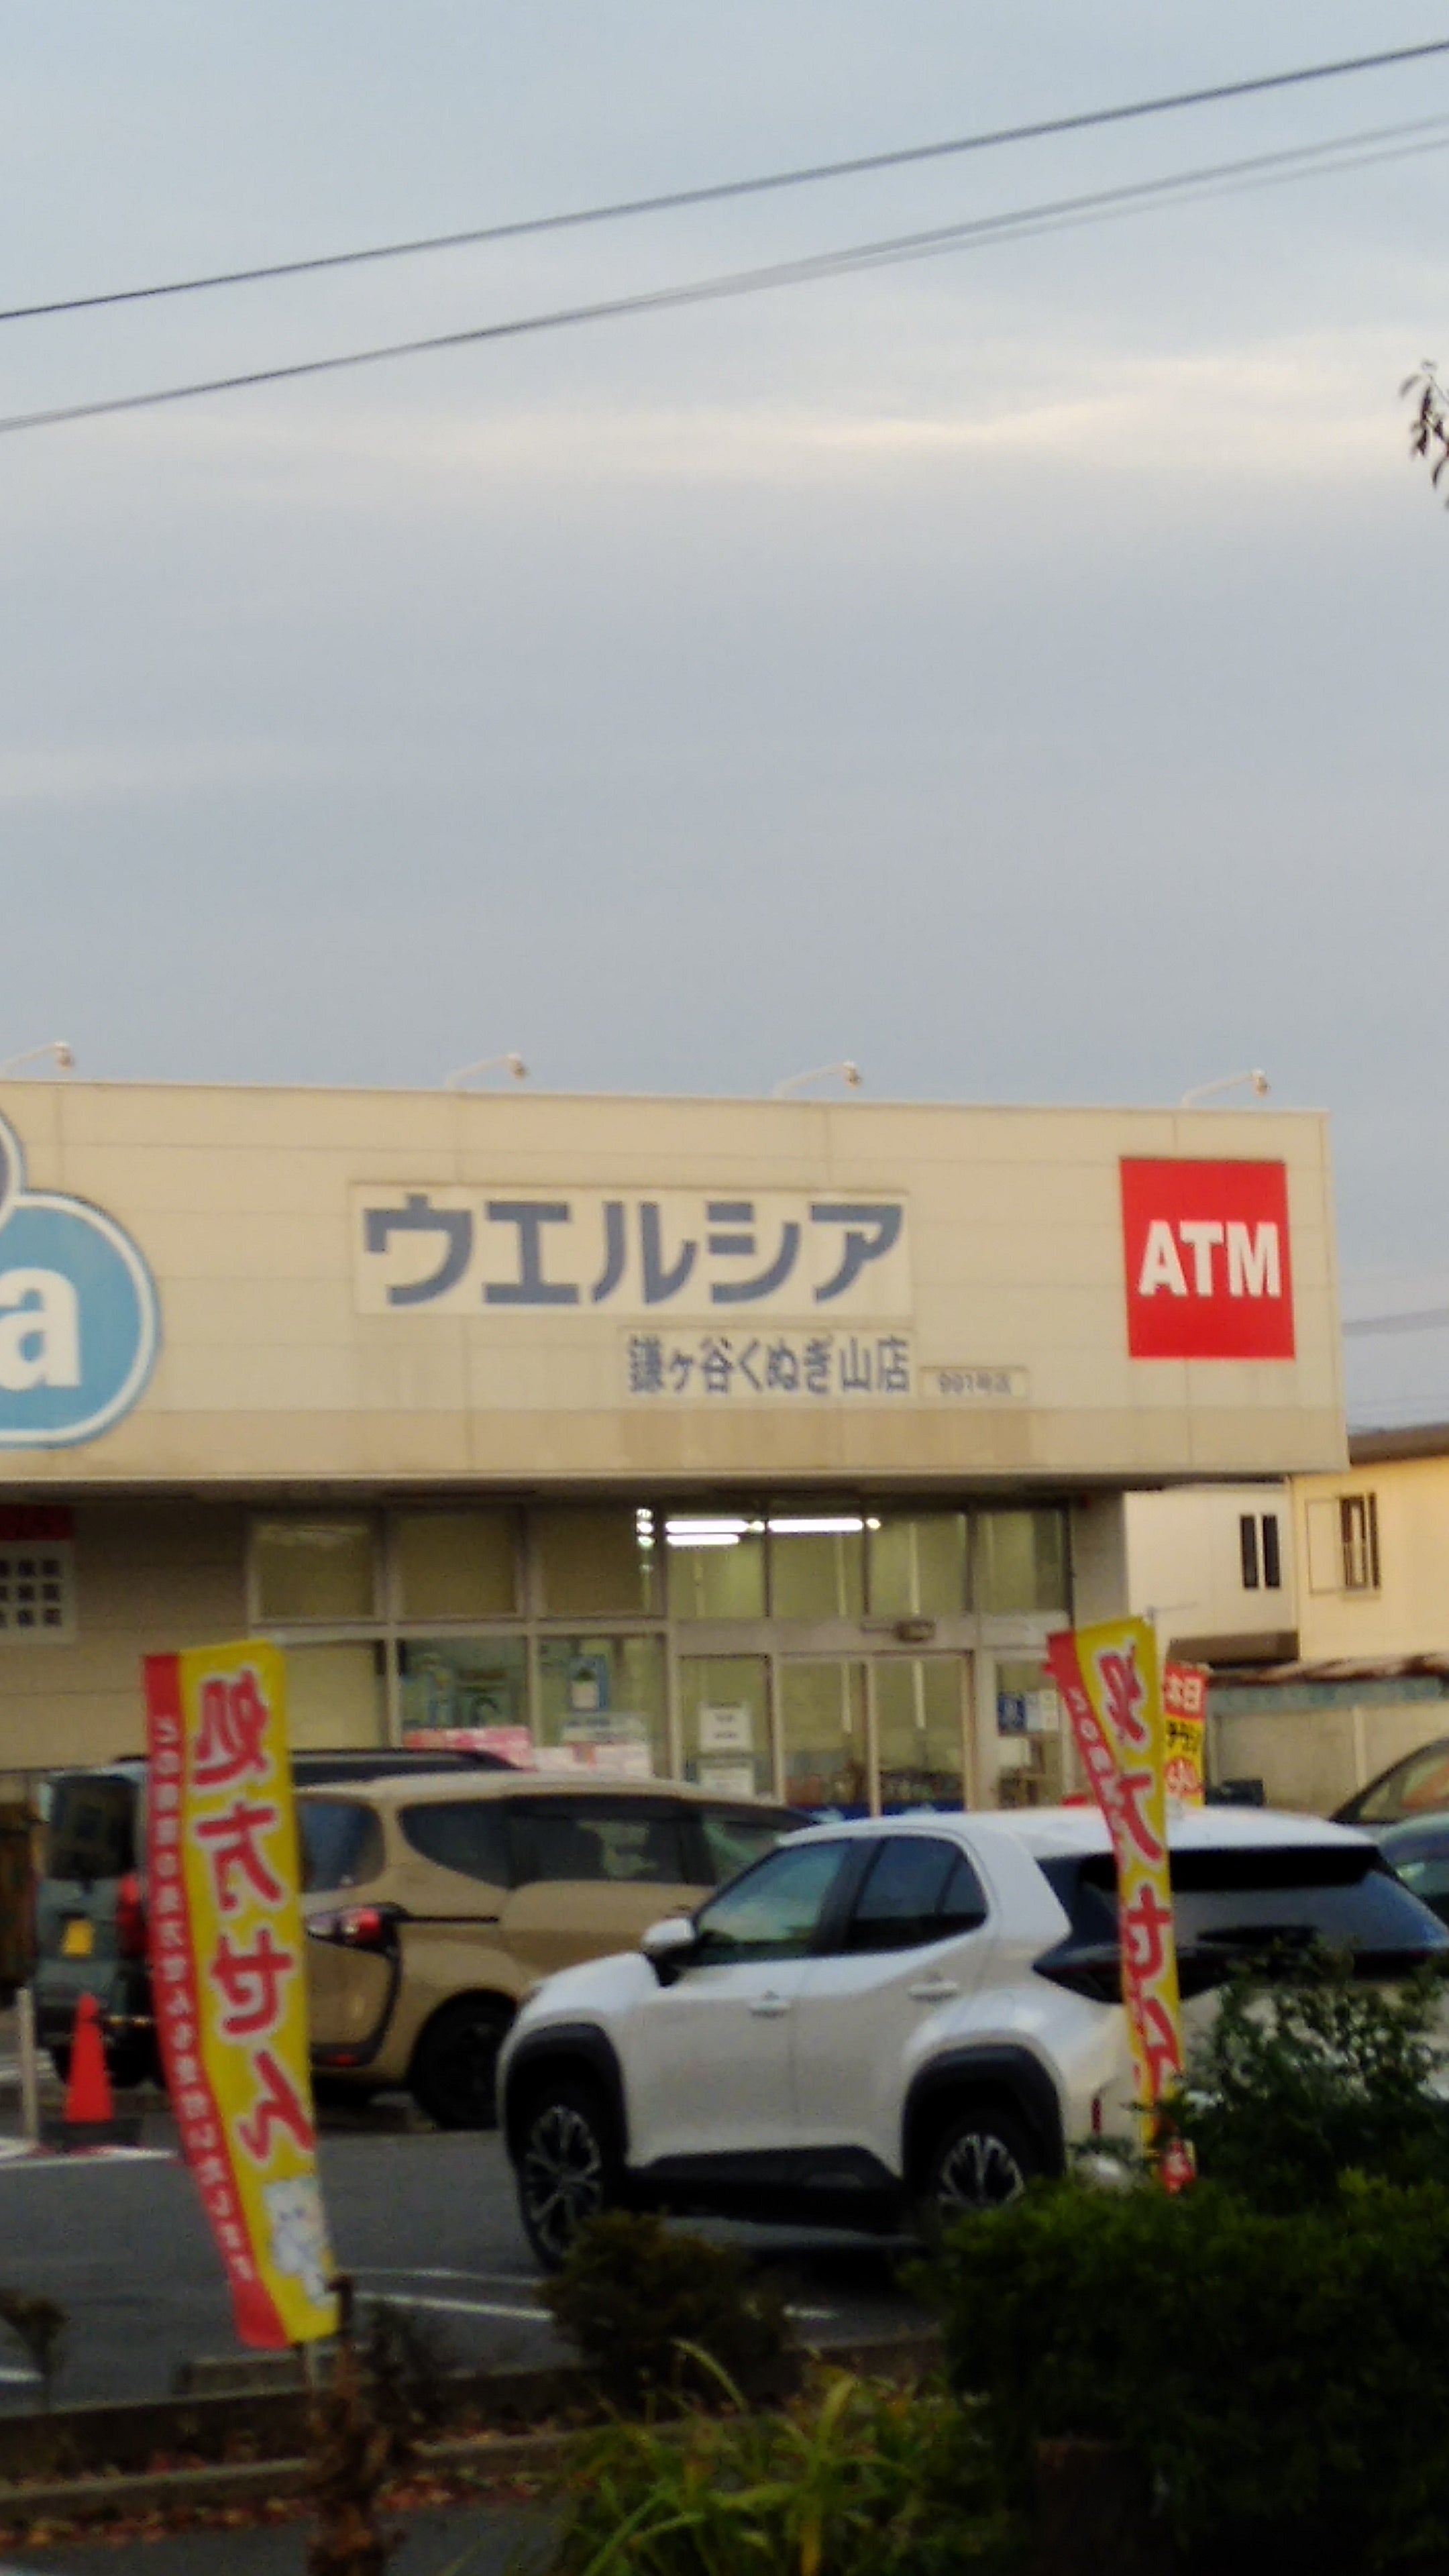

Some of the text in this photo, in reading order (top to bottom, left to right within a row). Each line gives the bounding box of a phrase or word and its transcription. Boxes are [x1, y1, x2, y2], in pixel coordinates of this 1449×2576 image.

[363, 1193, 904, 1306] ウエルシア
[1138, 1220, 1281, 1299] ATM
